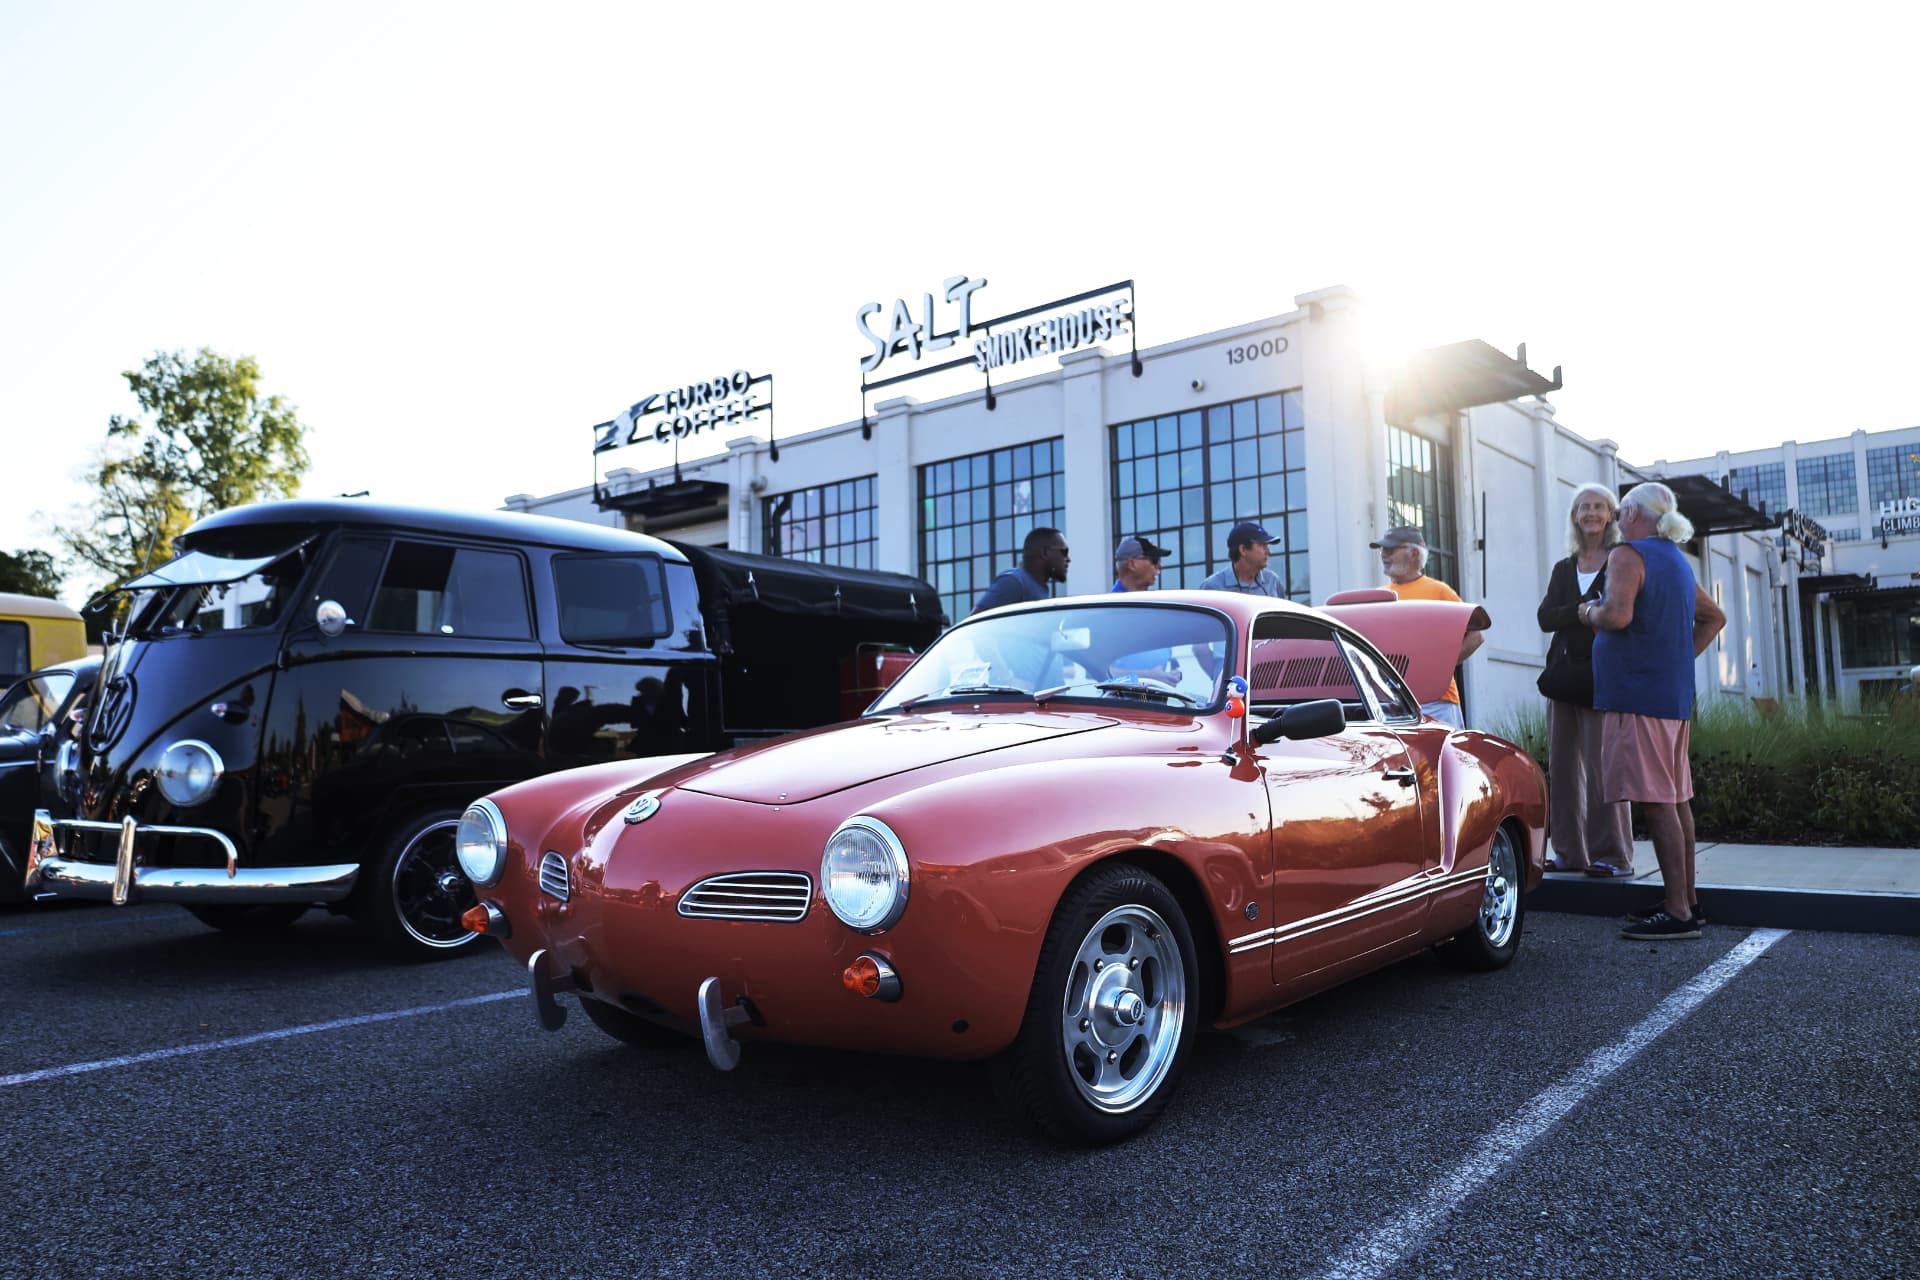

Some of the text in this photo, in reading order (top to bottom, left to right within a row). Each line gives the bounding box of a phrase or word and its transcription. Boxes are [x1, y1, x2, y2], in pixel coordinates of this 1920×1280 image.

[856, 275, 1129, 372] SALT SMOKEHOUSE
[1226, 337, 1289, 365] 1300D
[664, 369, 752, 415] TURBO
[652, 395, 758, 444] COFFEE
